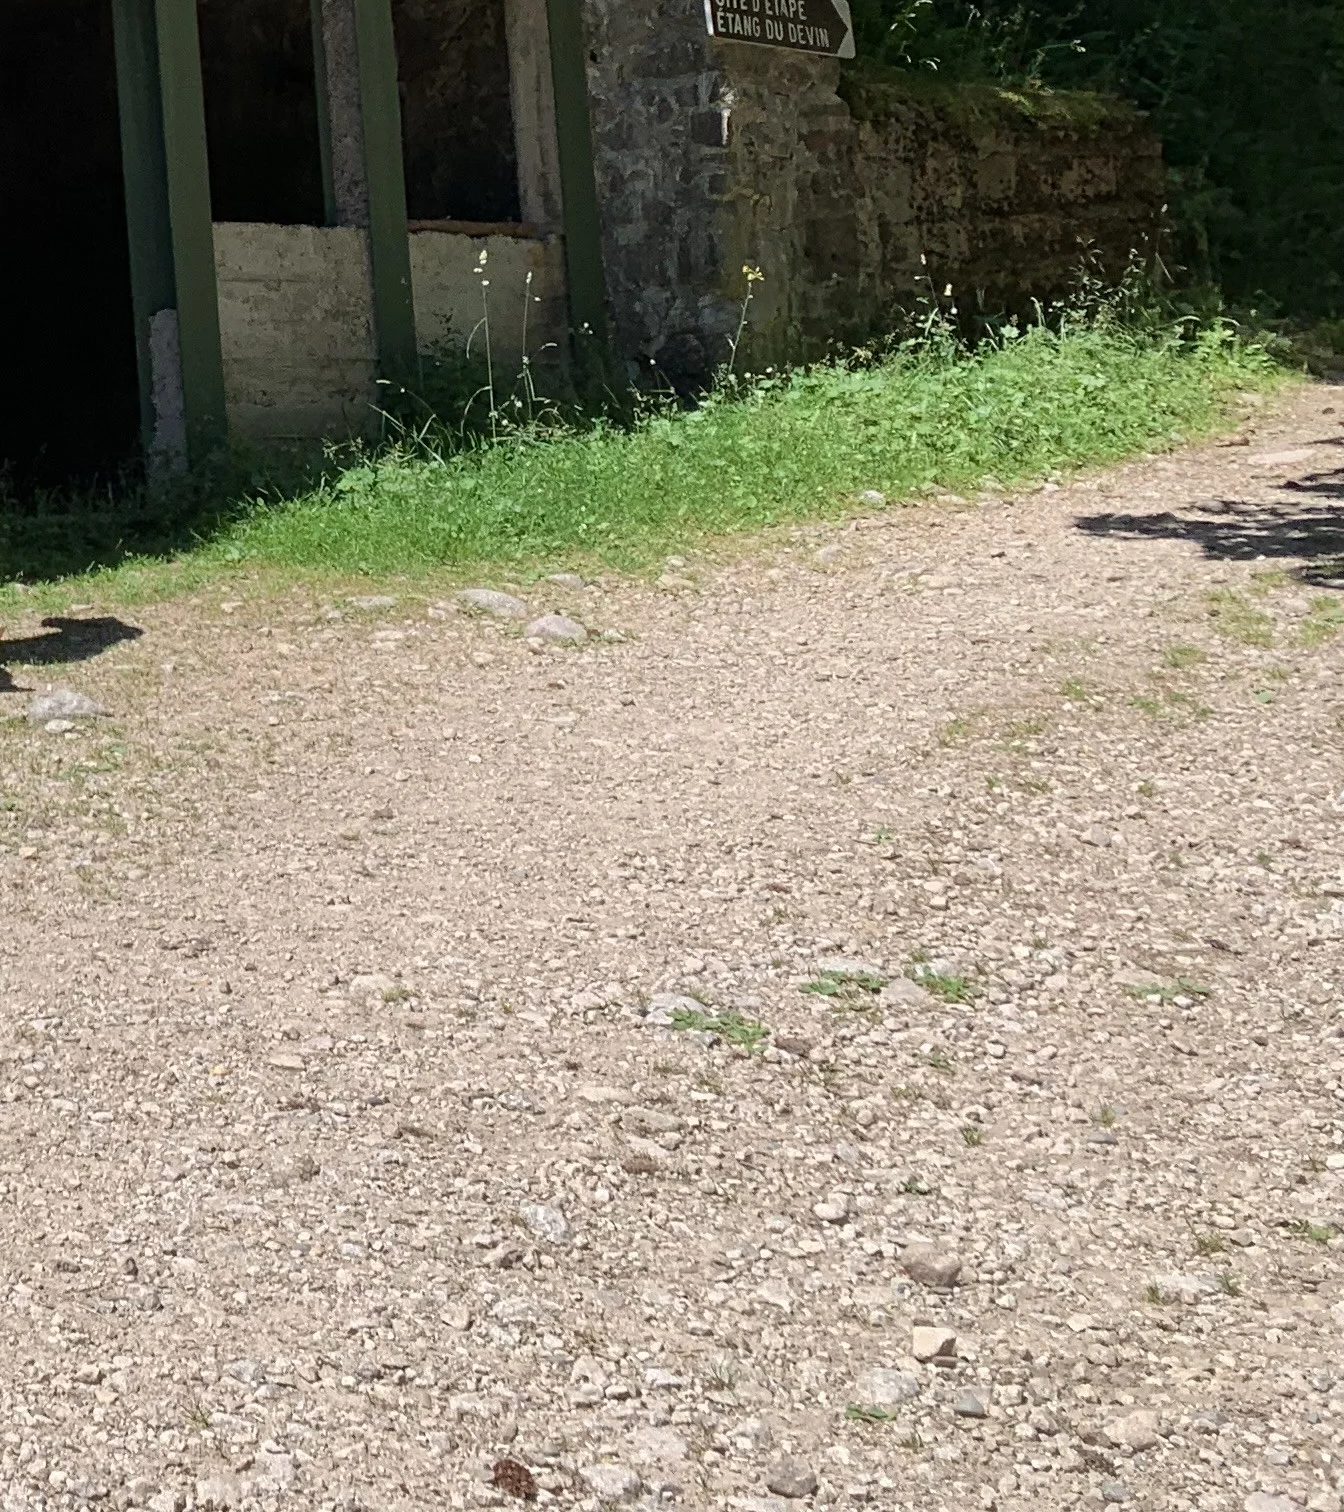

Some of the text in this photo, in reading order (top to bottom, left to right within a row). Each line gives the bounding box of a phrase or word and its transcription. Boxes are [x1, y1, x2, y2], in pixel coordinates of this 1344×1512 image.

[716, 6, 830, 48] ÉTANG DU DEVIN
